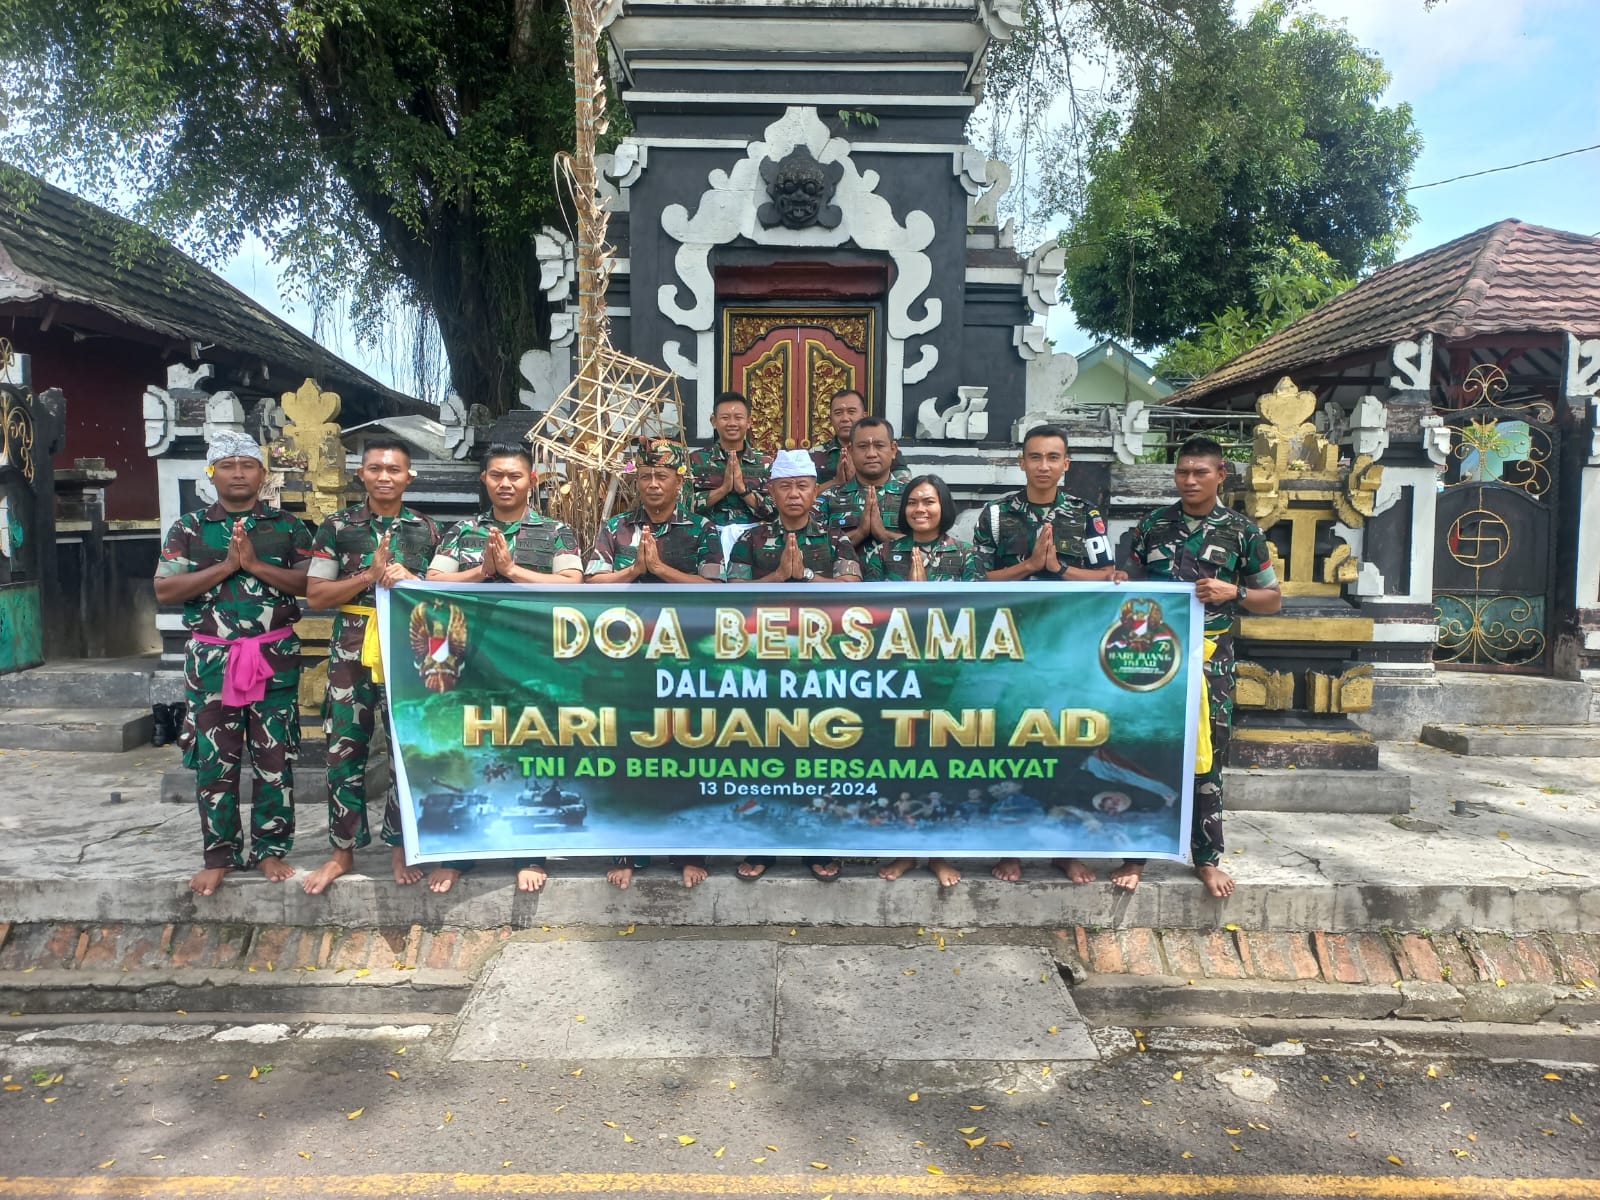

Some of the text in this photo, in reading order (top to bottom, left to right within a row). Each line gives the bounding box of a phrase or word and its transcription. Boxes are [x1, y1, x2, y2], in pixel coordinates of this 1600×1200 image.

[551, 606, 1025, 662] DOA BERSAMA
[656, 668, 922, 700] DALAM RANGKA
[463, 705, 1111, 749] HARI JUANG TNI AD
[518, 757, 1055, 780] TNI AD BERJUANG BERSAMA RAKYAT
[698, 781, 878, 797] 13 Desember 2024
